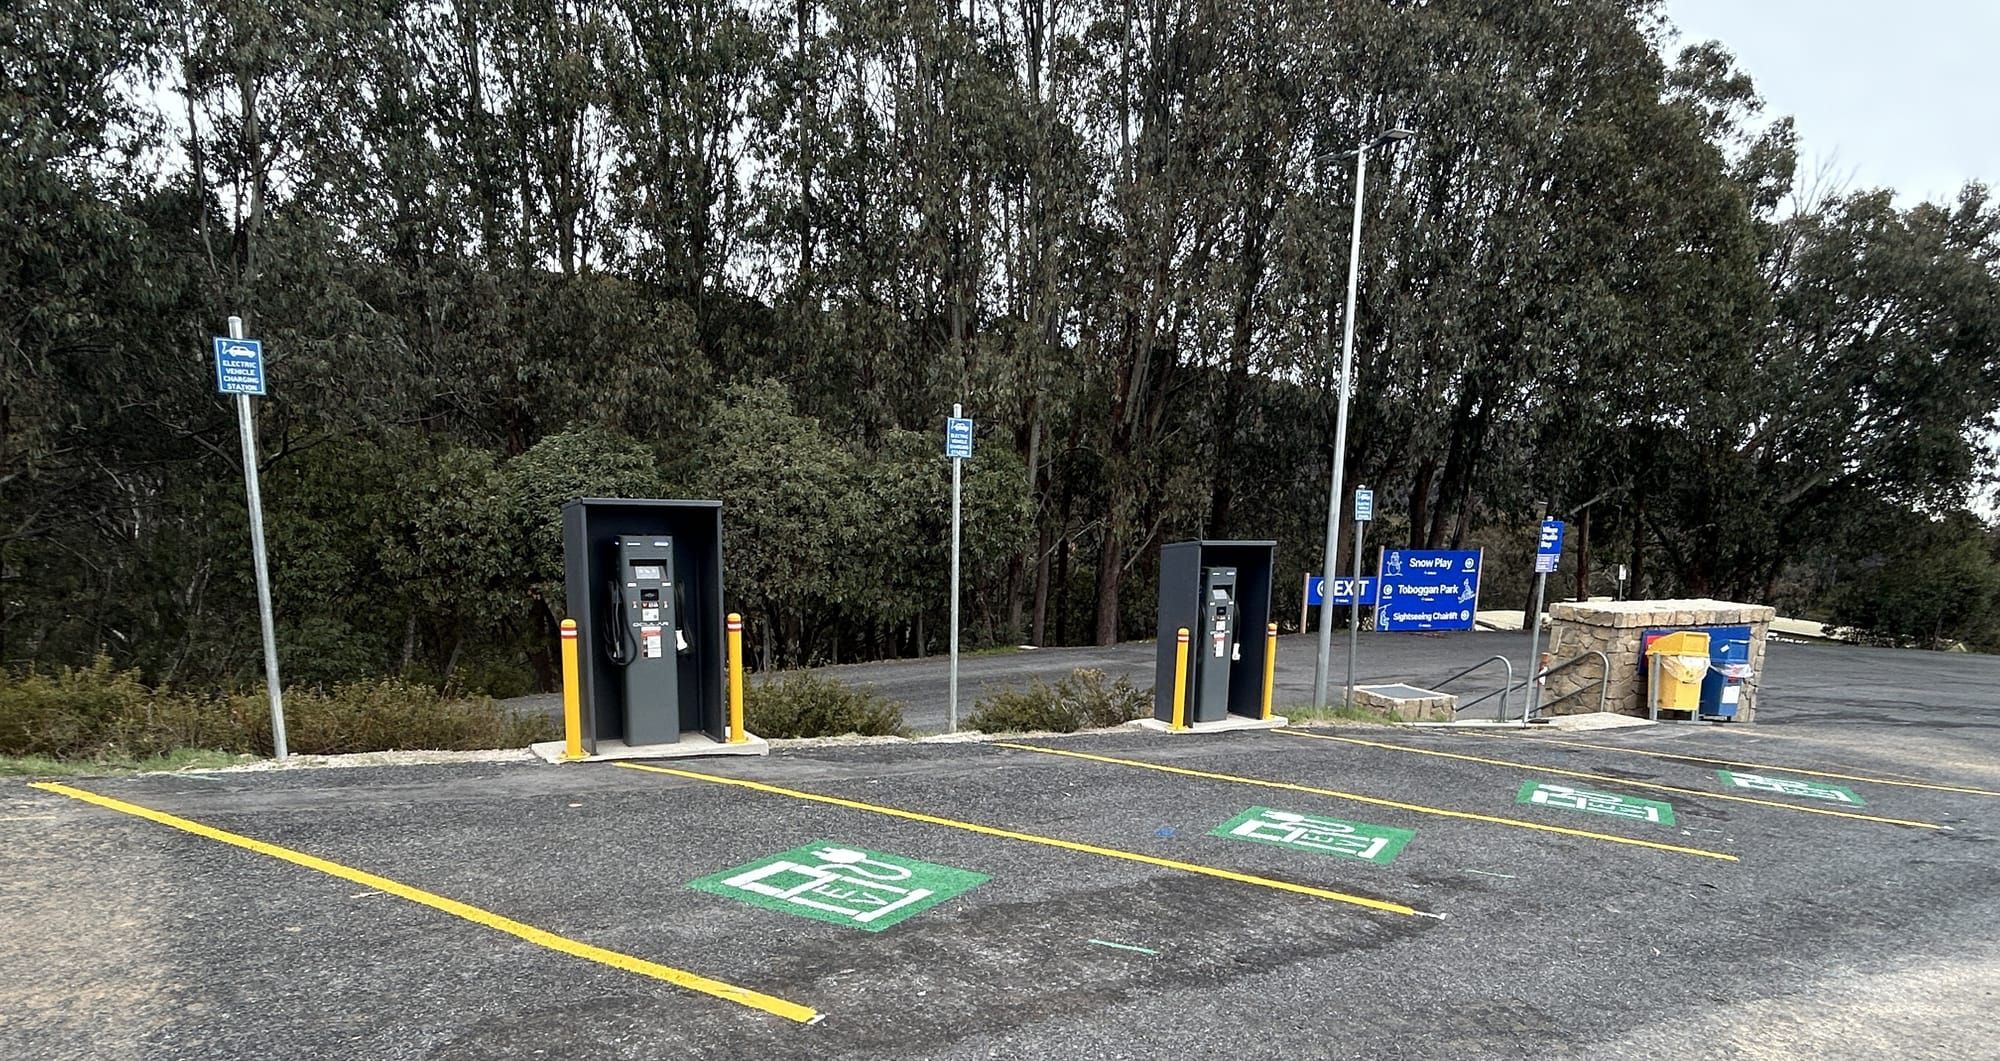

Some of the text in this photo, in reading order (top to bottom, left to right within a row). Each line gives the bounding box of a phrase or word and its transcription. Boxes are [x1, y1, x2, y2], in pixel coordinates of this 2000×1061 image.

[222, 360, 257, 369] ELECTRIC
[225, 368, 256, 376] VEHICLE
[223, 376, 260, 384] CHARGING
[226, 383, 258, 391] STATION
[1409, 558, 1453, 570] Snow Play
[1333, 580, 1370, 597] EXT
[1397, 584, 1459, 597] Toboggan Park
[1392, 611, 1458, 622] Sightseeing Chairlift
[1301, 830, 1368, 849] EV
[810, 883, 890, 906] EV
